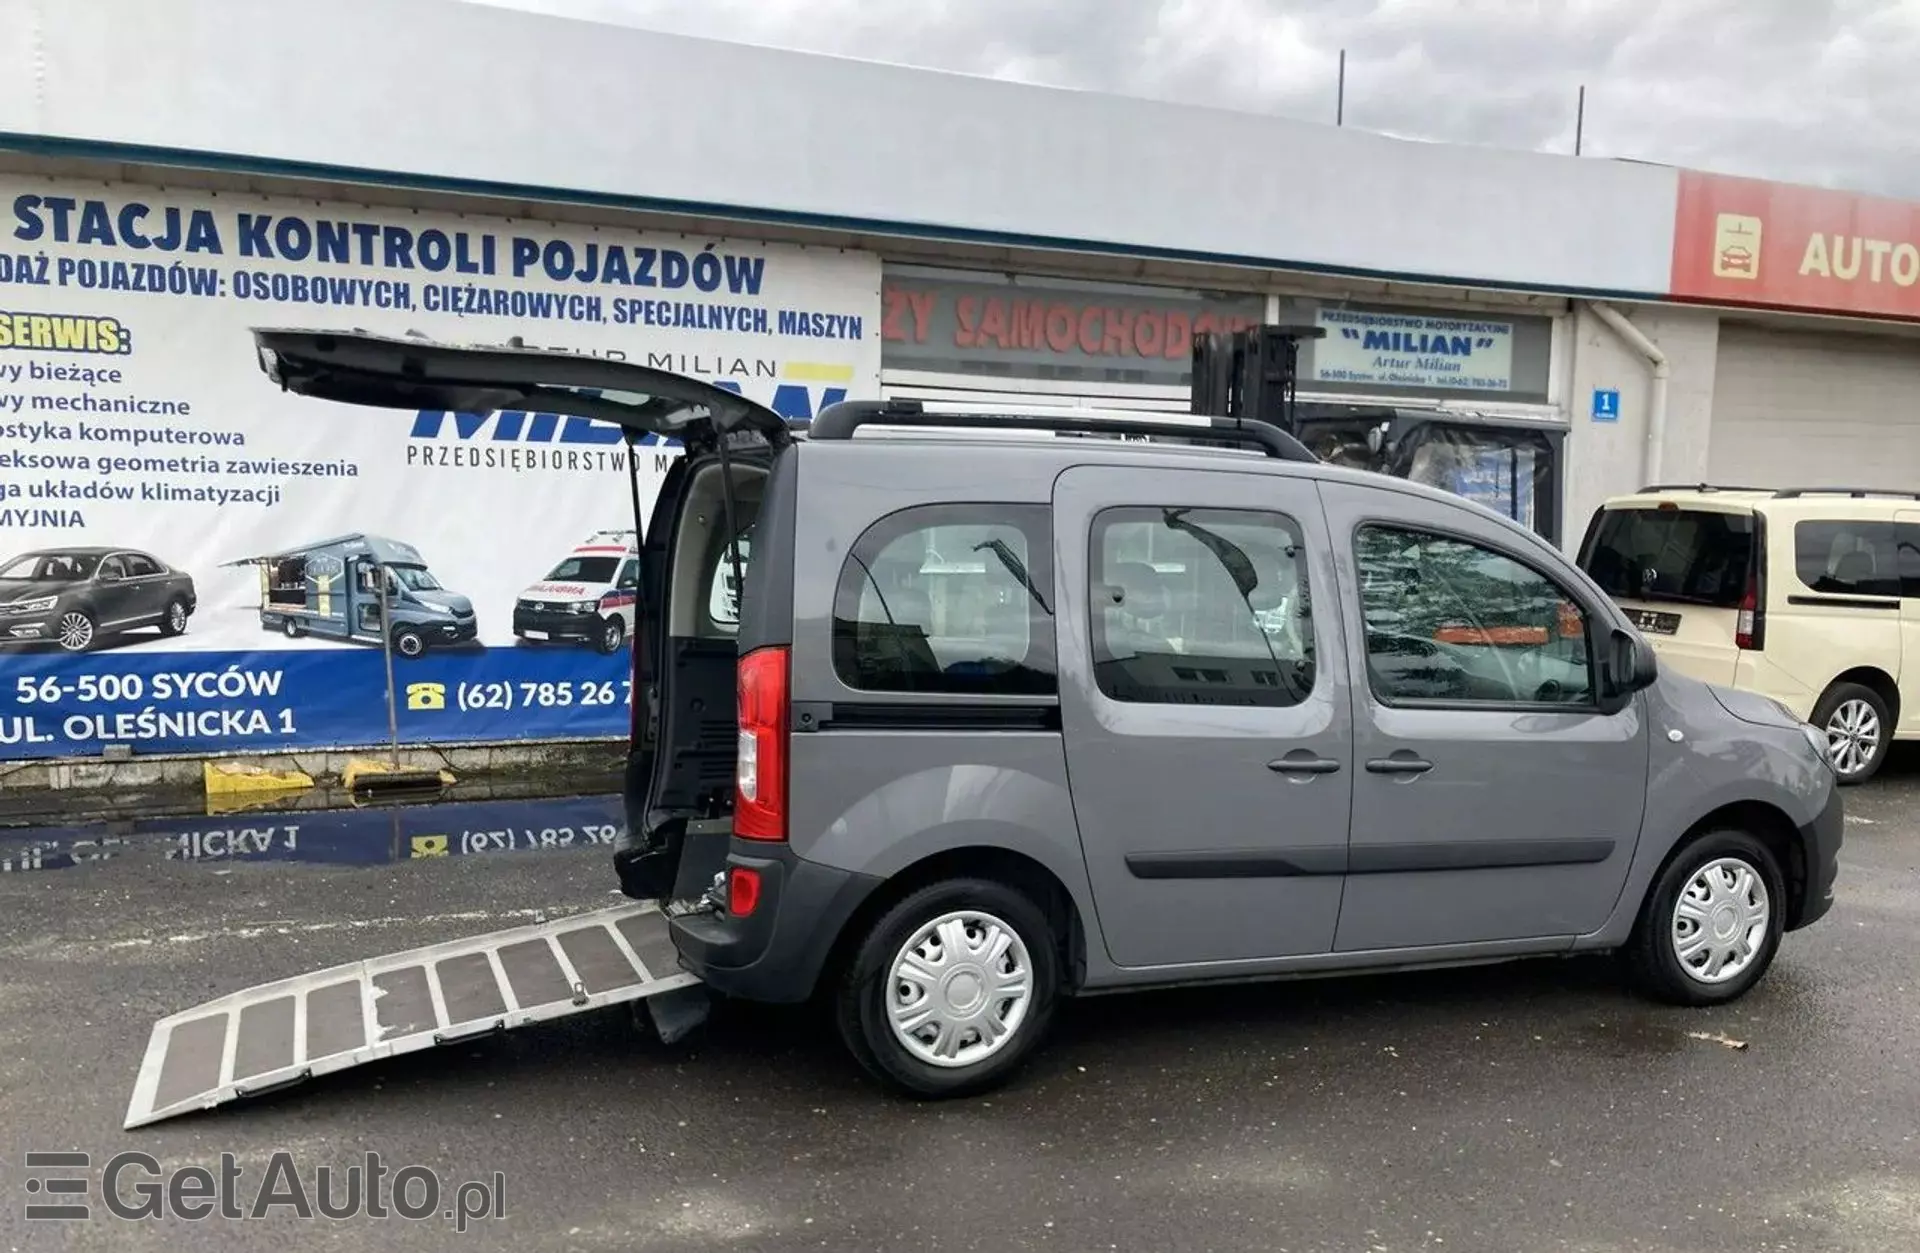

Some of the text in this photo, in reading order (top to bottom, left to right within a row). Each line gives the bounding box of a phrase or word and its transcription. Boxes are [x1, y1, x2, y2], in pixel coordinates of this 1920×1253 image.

[13, 194, 765, 296] STACJA KONTROLI POJAZDÓW
[1798, 232, 1920, 287] AUTO
[58, 257, 226, 297] POJAZDÓW:
[233, 270, 417, 313] OSOBOWYCH,
[424, 283, 606, 325] CIĘŻAROWYCH,
[613, 298, 773, 336] SPECJALNYCH,
[778, 311, 862, 340] MASZYN
[0, 311, 131, 354] SERWIS:
[30, 360, 122, 387] bieżące
[648, 353, 777, 378] MILIAN
[32, 392, 191, 416] mechaniczne
[1601, 393, 1611, 411] 1
[0, 420, 245, 447] styka komputerowa
[0, 449, 359, 478] eksowa geometria zawieszenia
[407, 444, 641, 473] PRZEDSIĘBIORSTWO
[29, 479, 134, 501] układów
[141, 482, 281, 507] klimatyzacji
[0, 508, 86, 528] MYJNIA
[16, 664, 283, 704] 56-500 SYCÓW
[458, 681, 513, 712] (62)
[520, 683, 573, 707] 785
[580, 681, 615, 705] 26
[0, 706, 297, 745] UL. OLEŚNICKA 1
